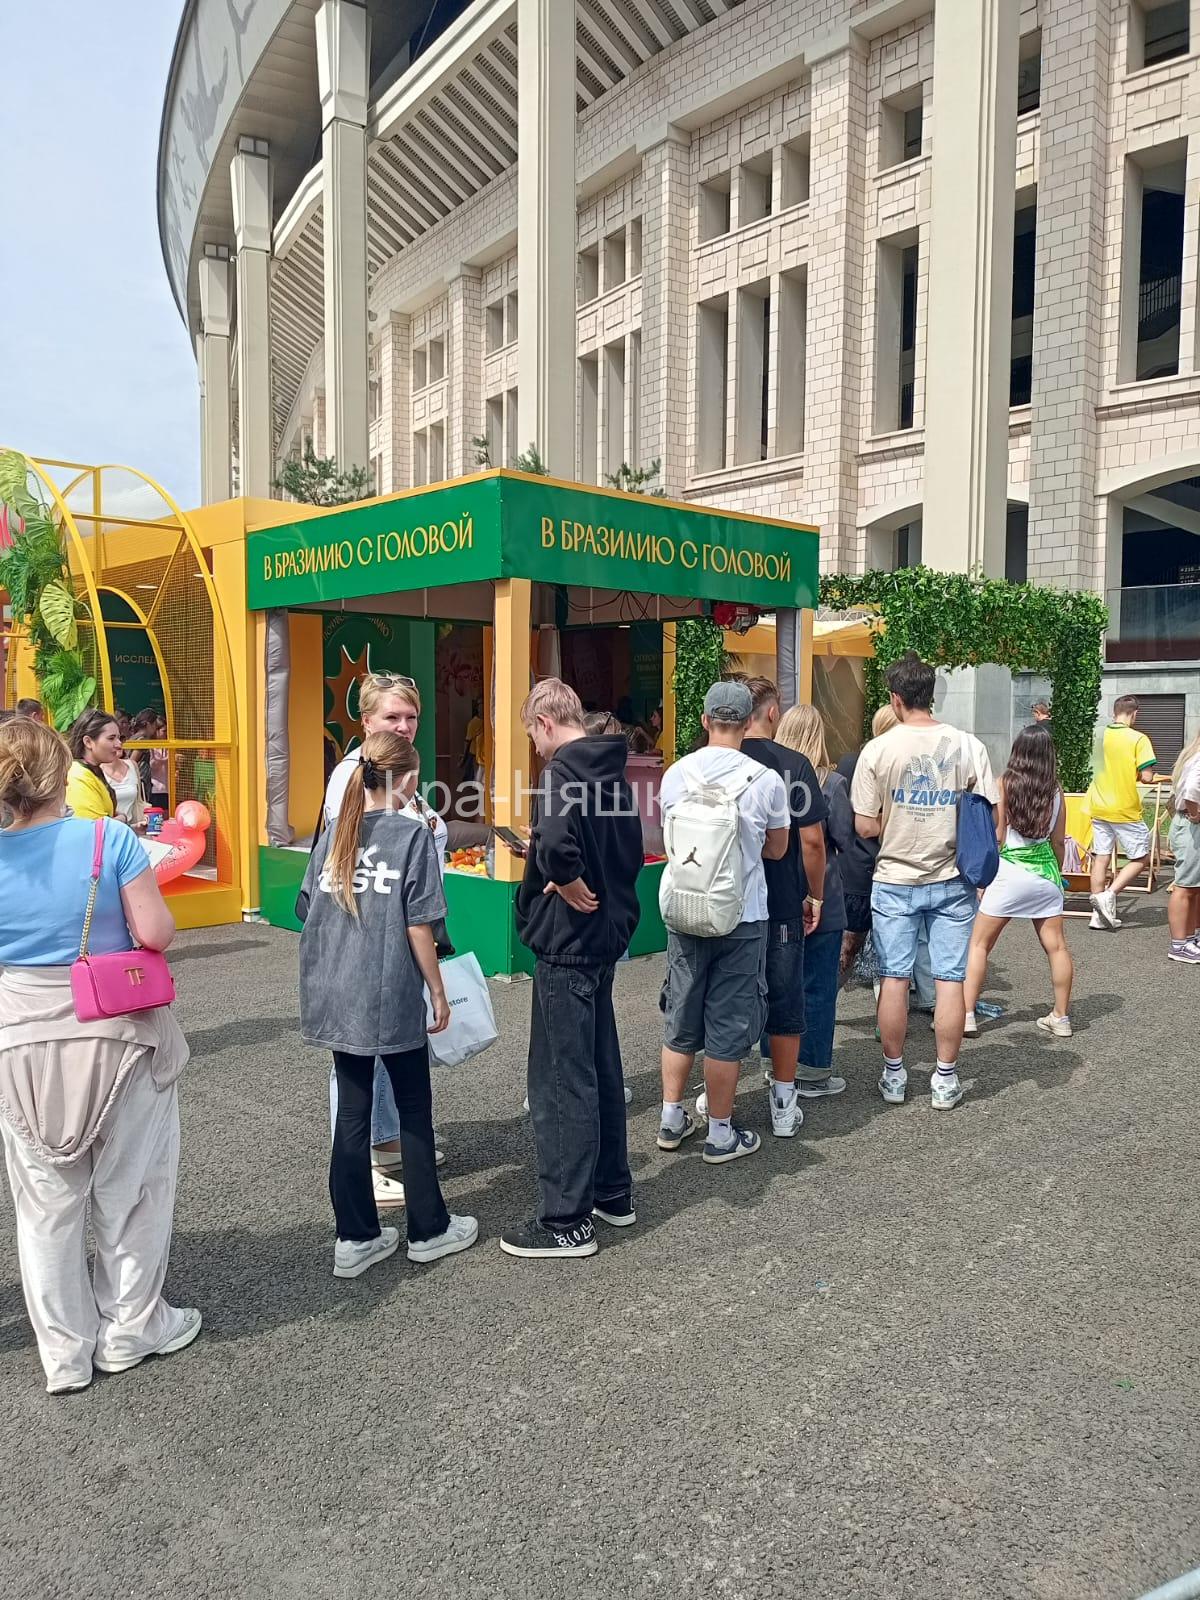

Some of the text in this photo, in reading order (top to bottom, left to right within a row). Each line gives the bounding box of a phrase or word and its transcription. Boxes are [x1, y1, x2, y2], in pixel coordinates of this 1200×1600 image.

[263, 511, 474, 581] В БРАЗИЛИЮ С ГОЛОВОЙ
[541, 516, 792, 583] В БРАЗИЛИЮ С ГОЛОВОЙ
